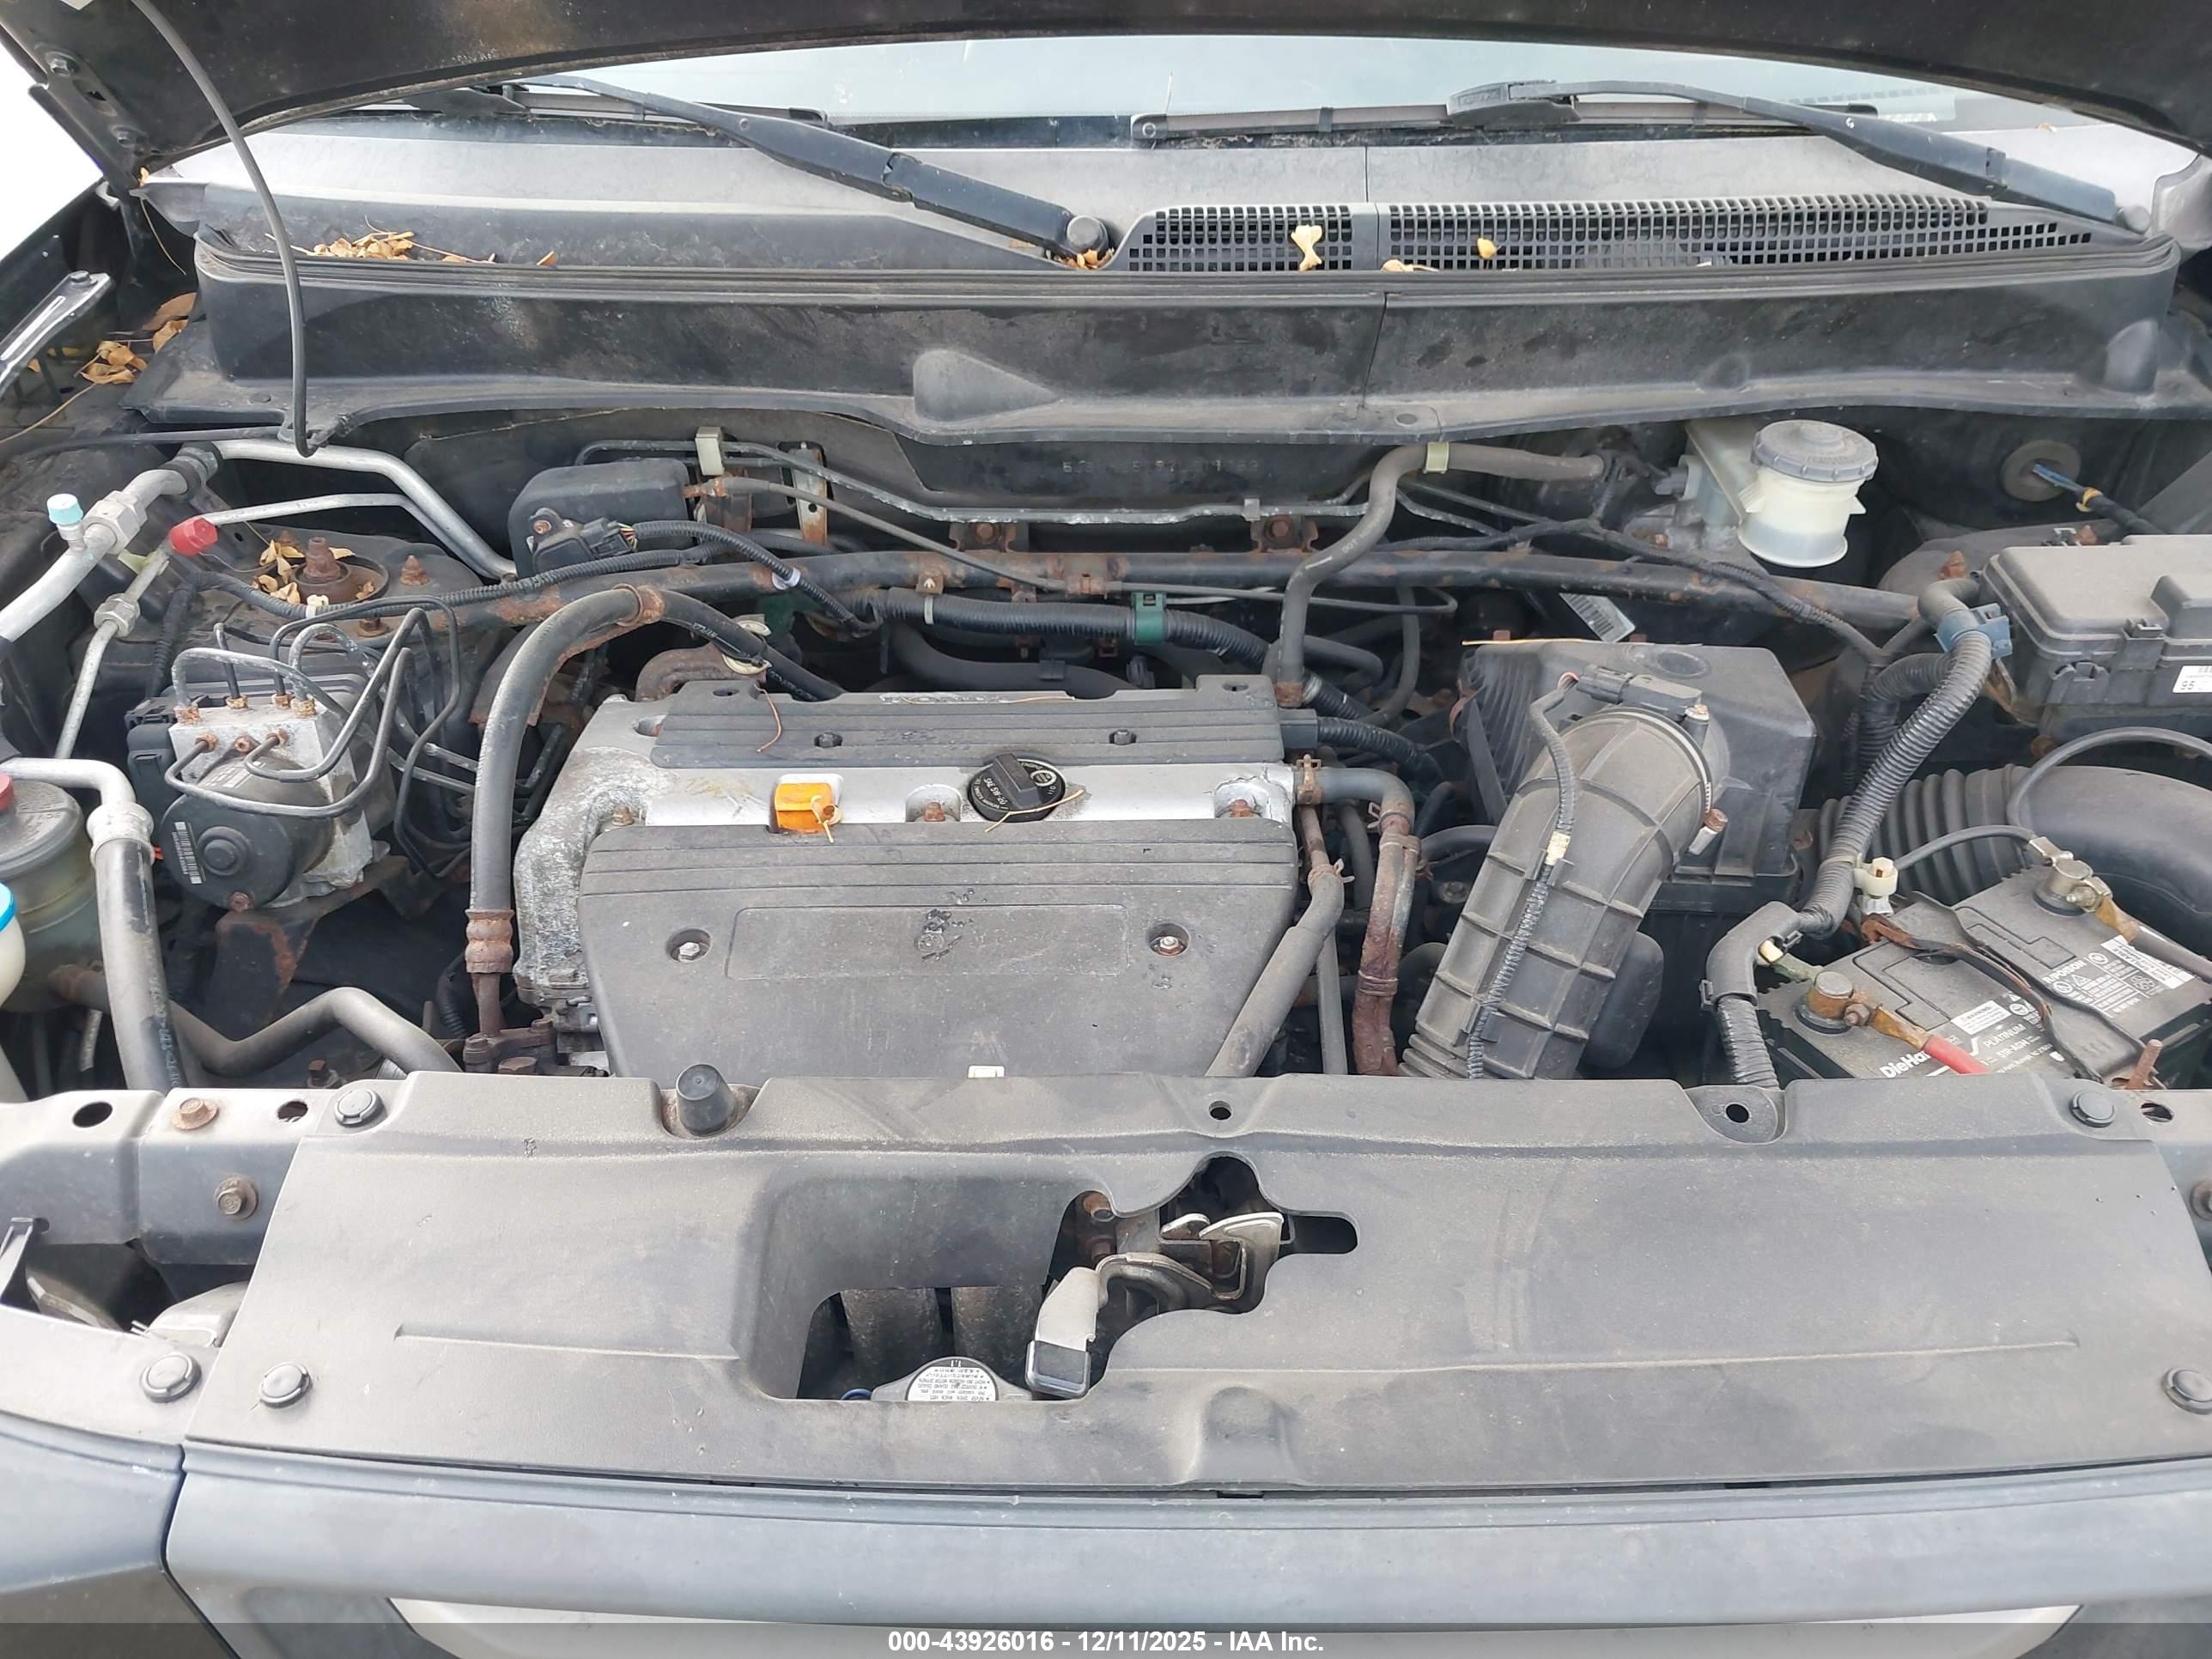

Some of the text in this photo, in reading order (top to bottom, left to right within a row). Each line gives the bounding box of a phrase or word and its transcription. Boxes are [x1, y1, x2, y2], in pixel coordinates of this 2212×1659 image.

[983, 777, 1008, 805] SAE 5W-20
[1983, 1023, 2027, 1048] PLATINUM
[1879, 1050, 1932, 1079] DieHar
